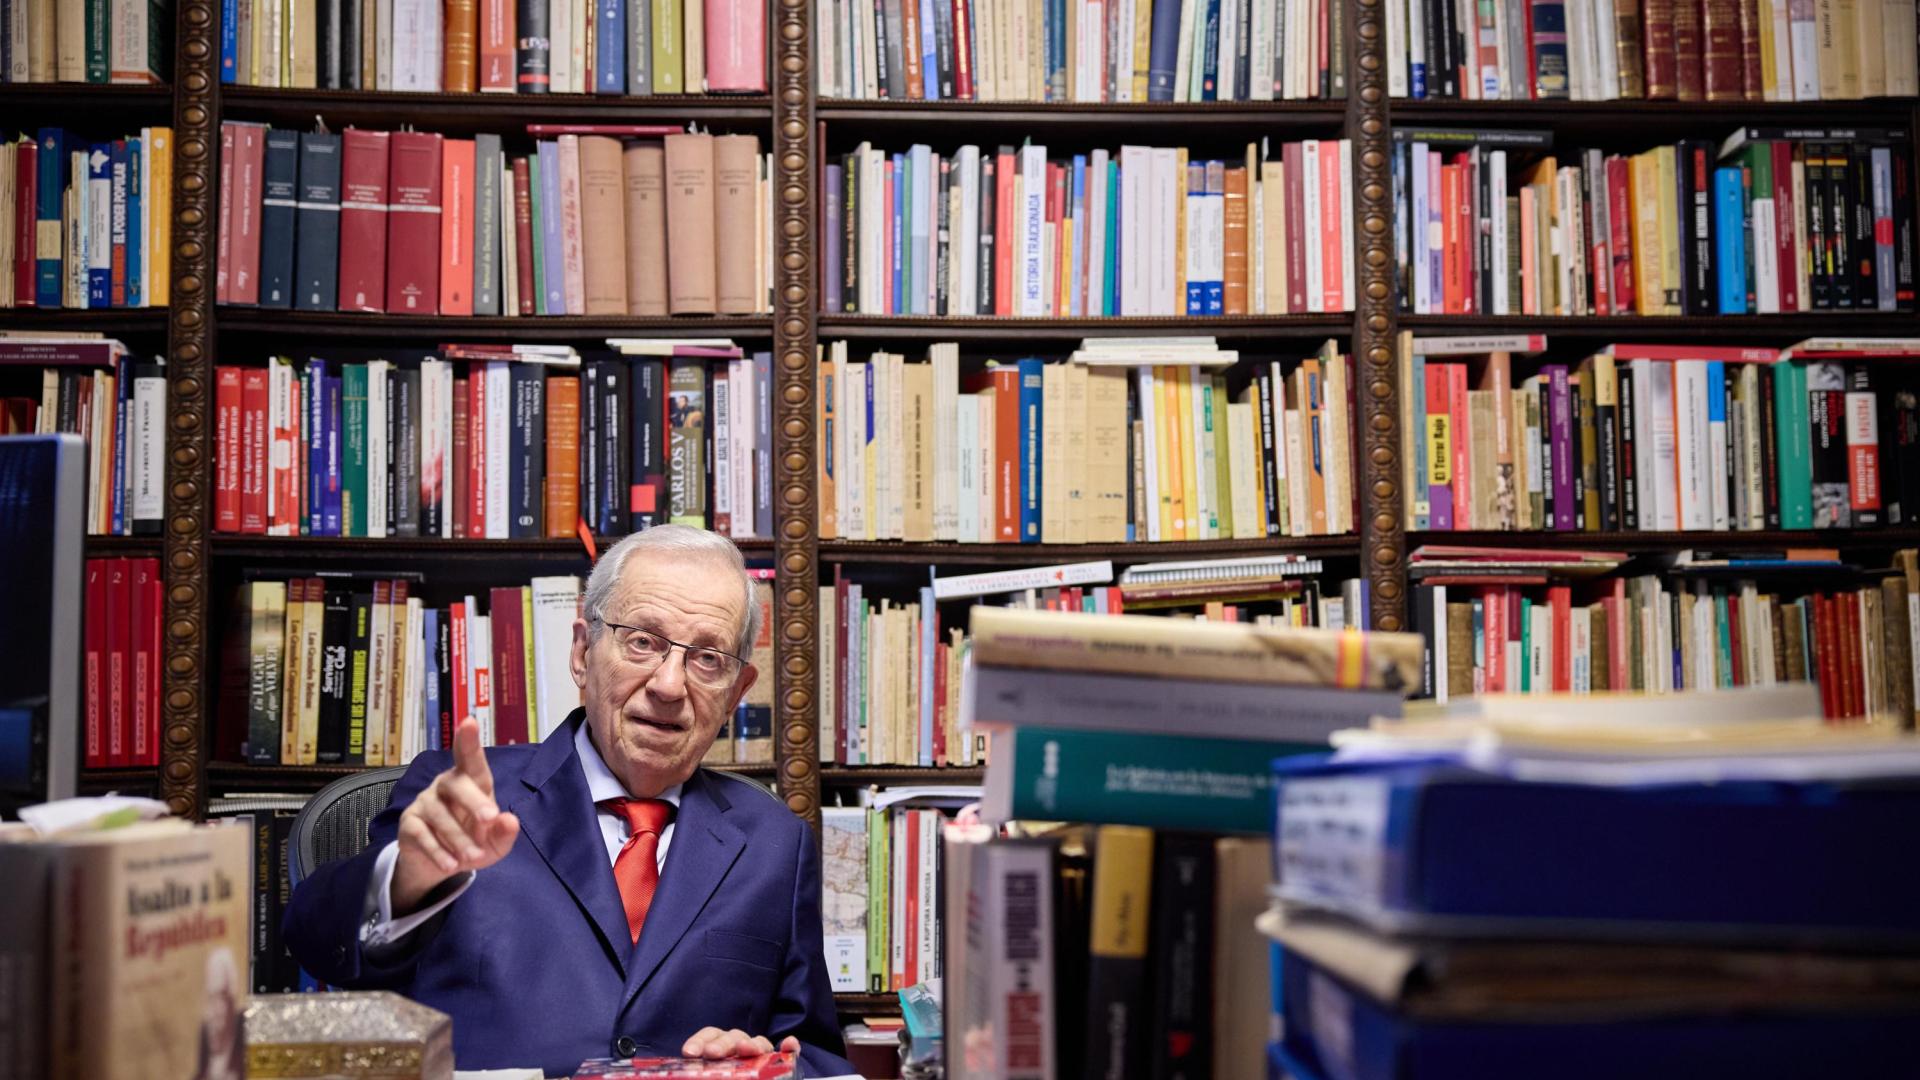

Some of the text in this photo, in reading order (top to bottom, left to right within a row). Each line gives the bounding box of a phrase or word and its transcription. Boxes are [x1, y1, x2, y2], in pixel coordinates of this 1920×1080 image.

[114, 163, 126, 202] POPULAR
[114, 203, 126, 232] PODER
[1027, 194, 1040, 299] HISTORIA TRAICIONADA
[717, 384, 728, 426] DEMOCRACIA
[1433, 419, 1444, 480] El Terror Rojo
[671, 431, 684, 516] CARLOS V
[113, 572, 121, 583] 2
[138, 572, 146, 584] 3
[291, 620, 299, 633] Los
[394, 622, 402, 635] Los
[266, 644, 277, 691] VOLVER
[290, 635, 298, 668] Grandes
[307, 648, 315, 680] Grandes
[335, 646, 345, 669] Club
[375, 649, 384, 682] Grandes
[392, 637, 401, 670] Grandes
[253, 654, 264, 695] LUGAR
[924, 944, 930, 952] LA
